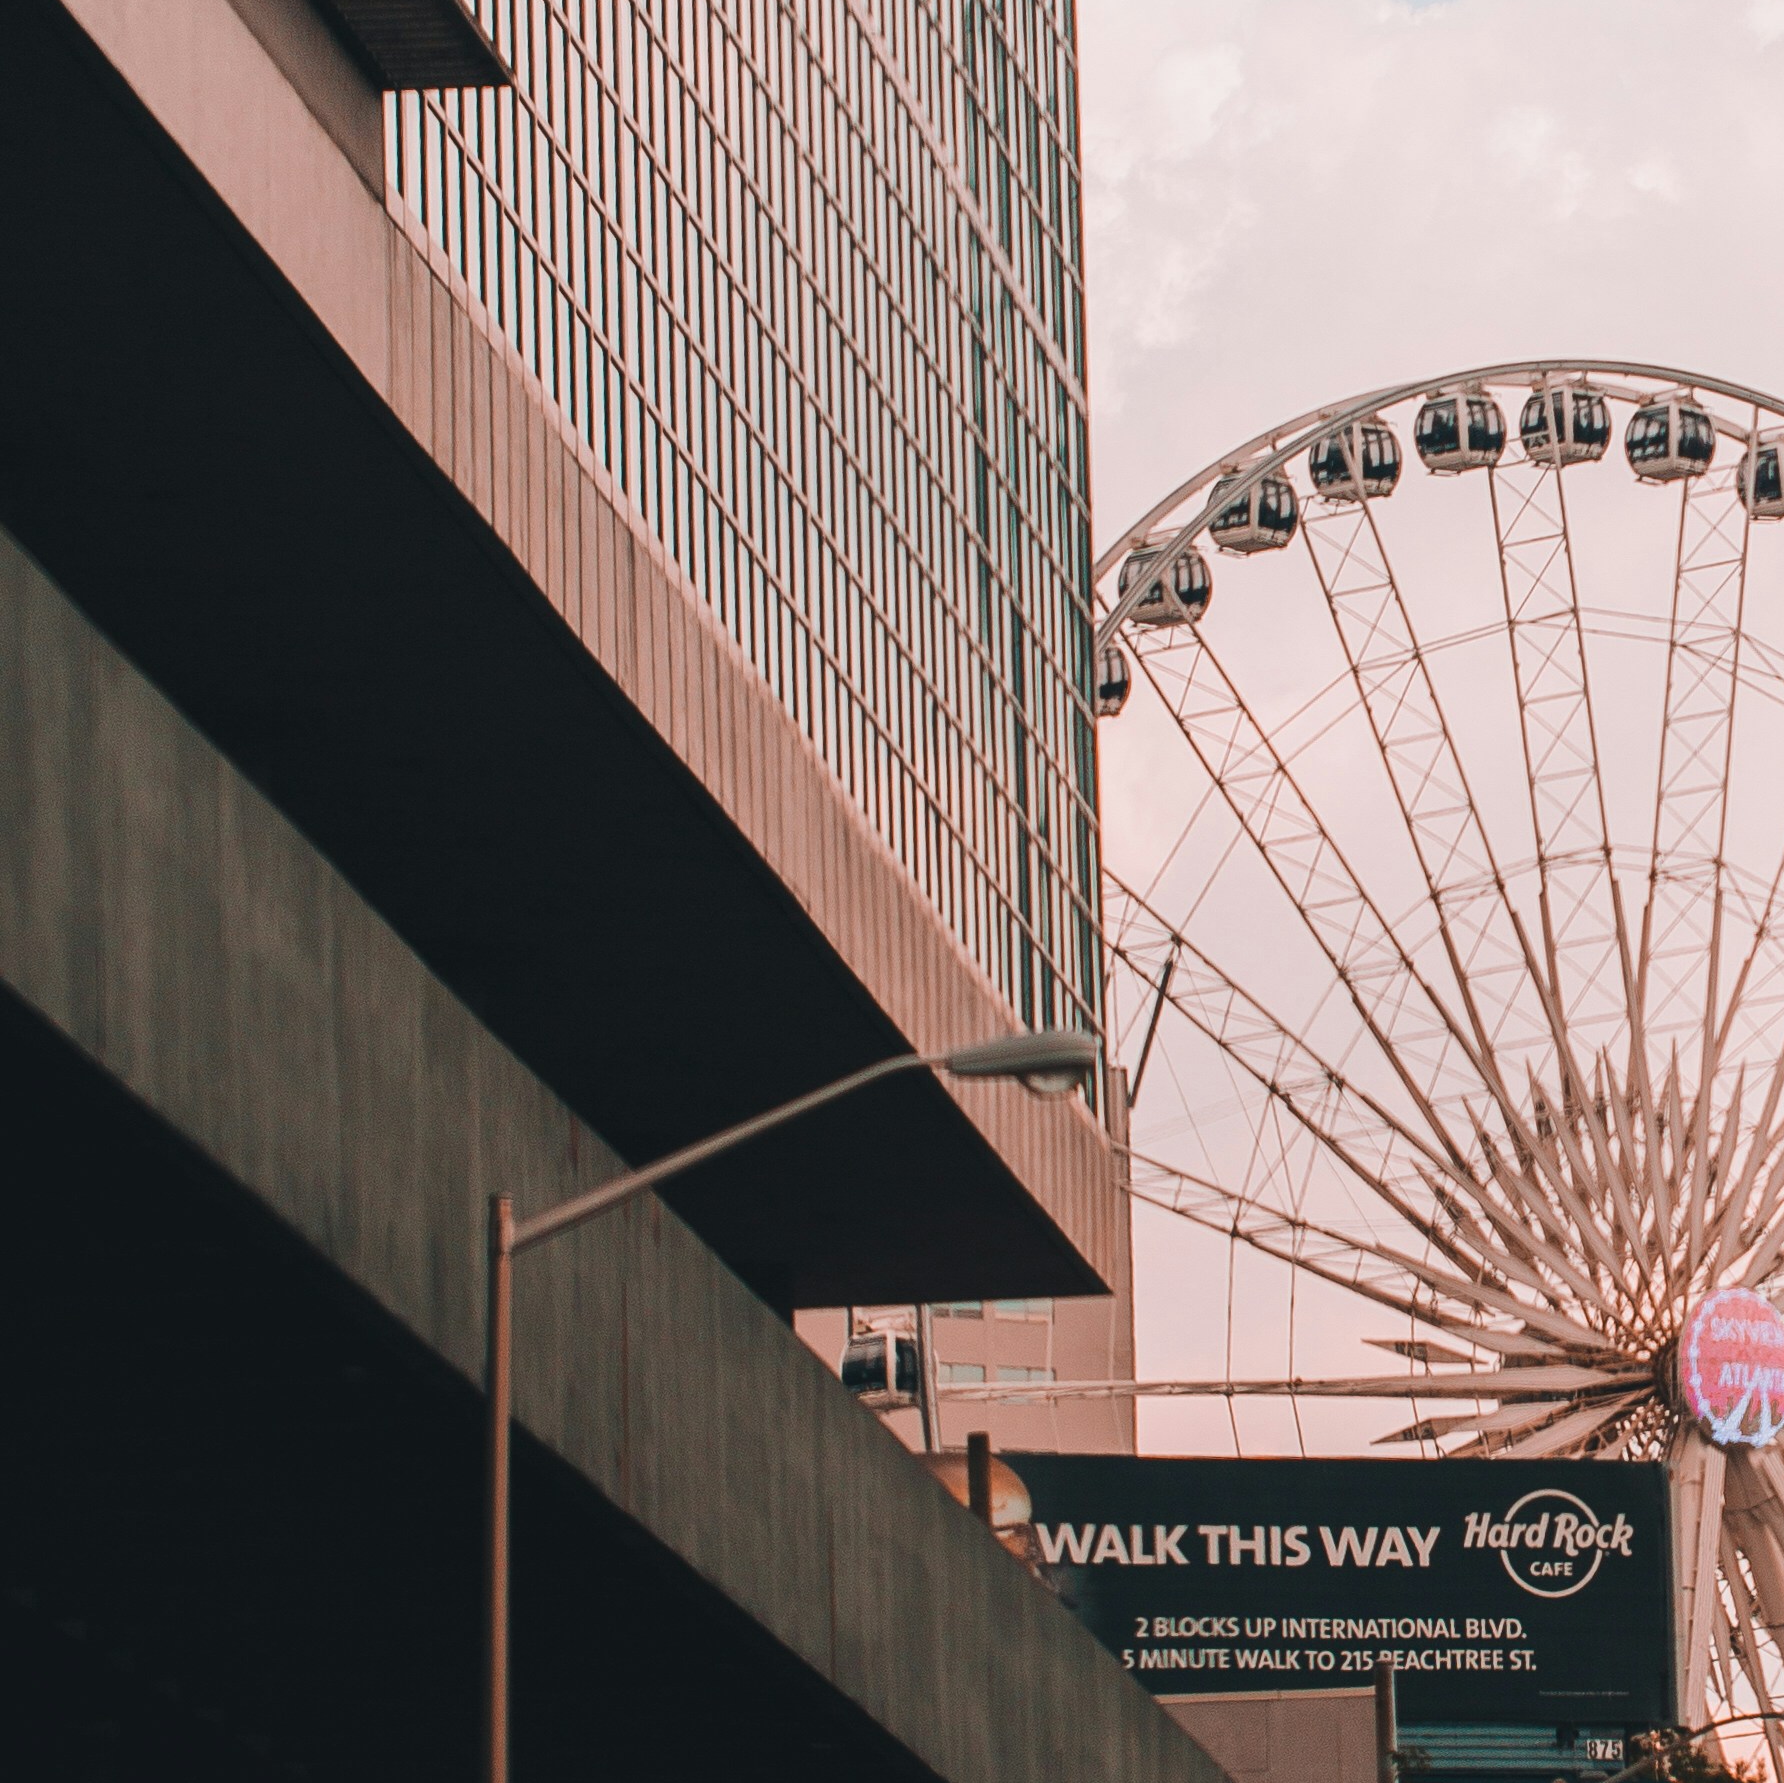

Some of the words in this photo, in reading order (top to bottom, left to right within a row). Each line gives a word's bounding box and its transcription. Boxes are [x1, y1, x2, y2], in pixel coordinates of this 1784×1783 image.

[1035, 1523, 1191, 1564] WALK
[1198, 1525, 1311, 1566] THIS
[1318, 1526, 1441, 1567] WAY
[1463, 1512, 1550, 1548] Hard
[1552, 1512, 1634, 1557] Rock
[1529, 1561, 1573, 1576] CAFE
[1135, 1617, 1149, 1638] 2
[1153, 1617, 1240, 1638] BLOCKS
[1245, 1618, 1276, 1638] UP
[1282, 1618, 1461, 1639] INTERNATIONAL
[1465, 1618, 1528, 1639] BLVD.
[1122, 1649, 1135, 1669] 5
[1140, 1649, 1231, 1669] MINUTE
[1234, 1650, 1301, 1670] WALK
[1304, 1650, 1336, 1670] TO
[1340, 1650, 1374, 1670] 215
[1508, 1649, 1537, 1670] ST.
[1588, 1741, 1620, 1759] 875
